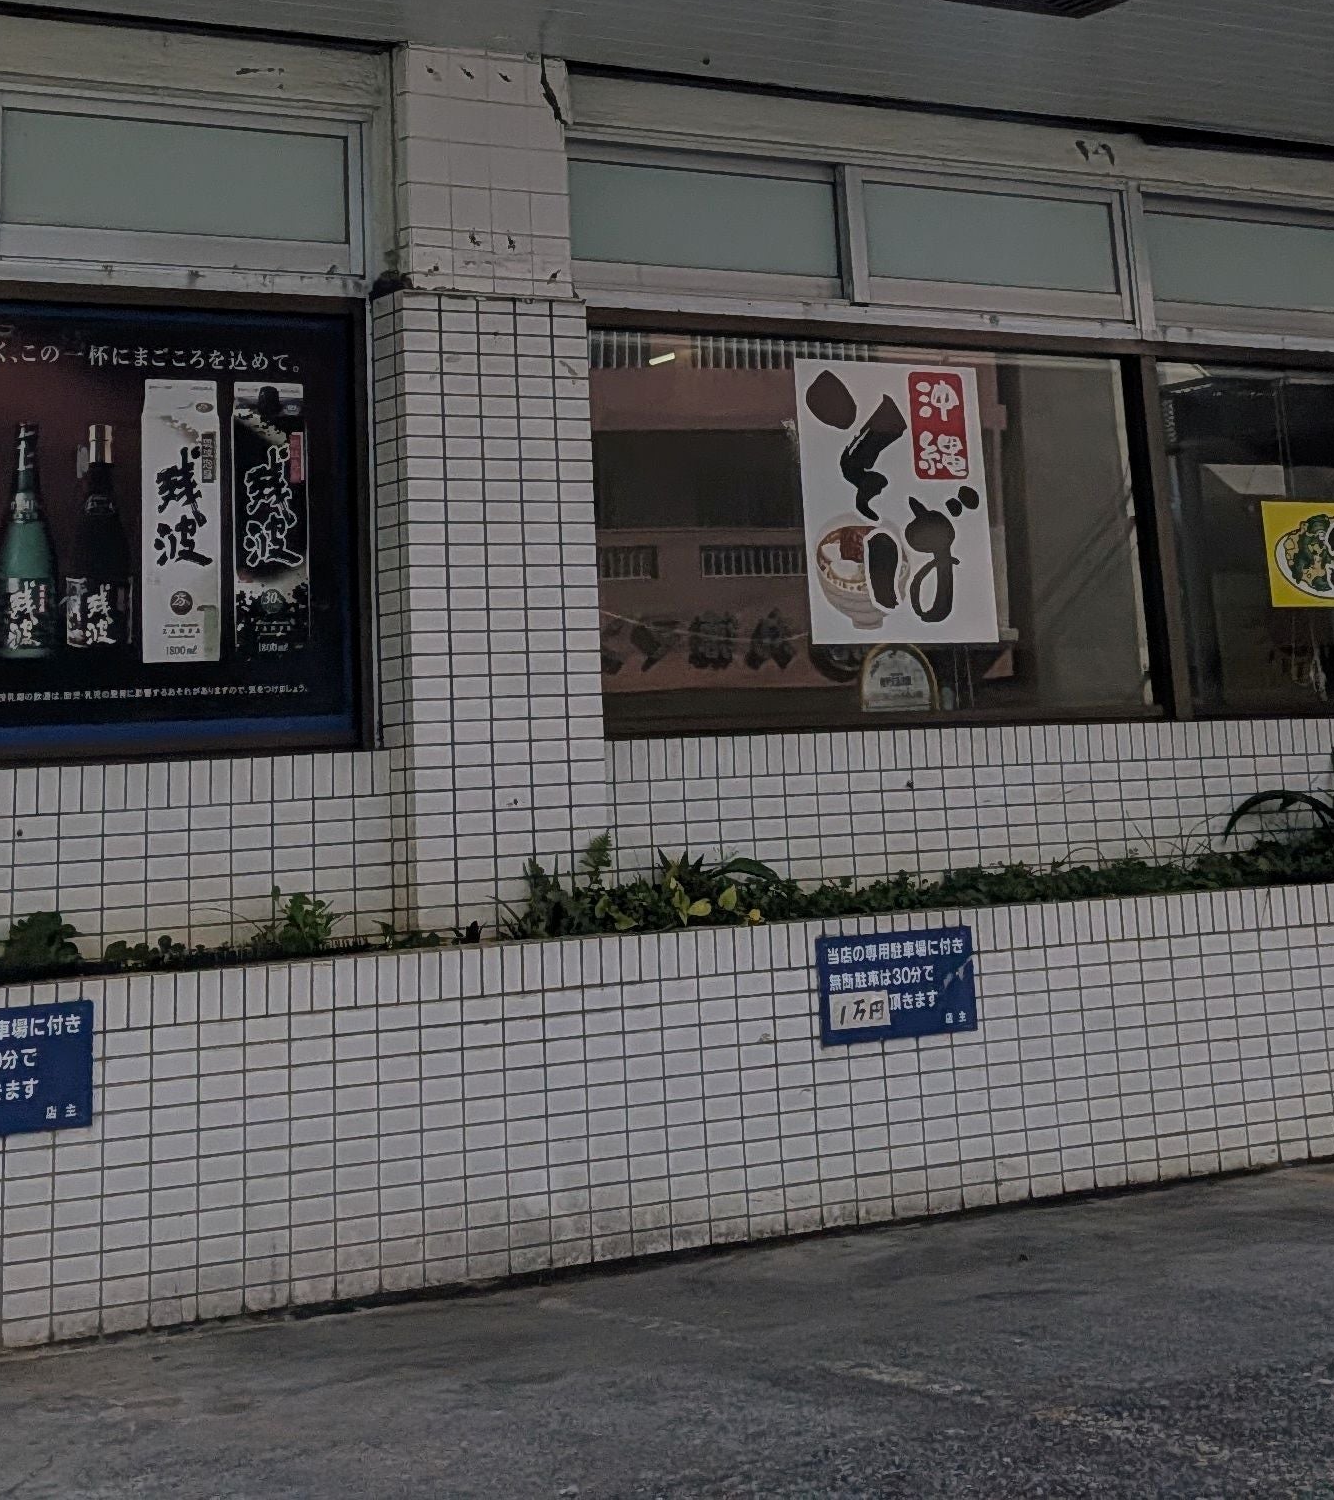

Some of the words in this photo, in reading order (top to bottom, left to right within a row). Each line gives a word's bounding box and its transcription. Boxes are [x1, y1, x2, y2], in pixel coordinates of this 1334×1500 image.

[916, 380, 968, 477] 沖縄
[154, 446, 213, 567] 残波
[243, 445, 304, 568] 残波
[805, 369, 980, 623] そば
[827, 937, 963, 965] 当店の専用駐車場に付き
[829, 964, 934, 991] 無断駐車は30分で
[889, 990, 939, 1011] 頂きます
